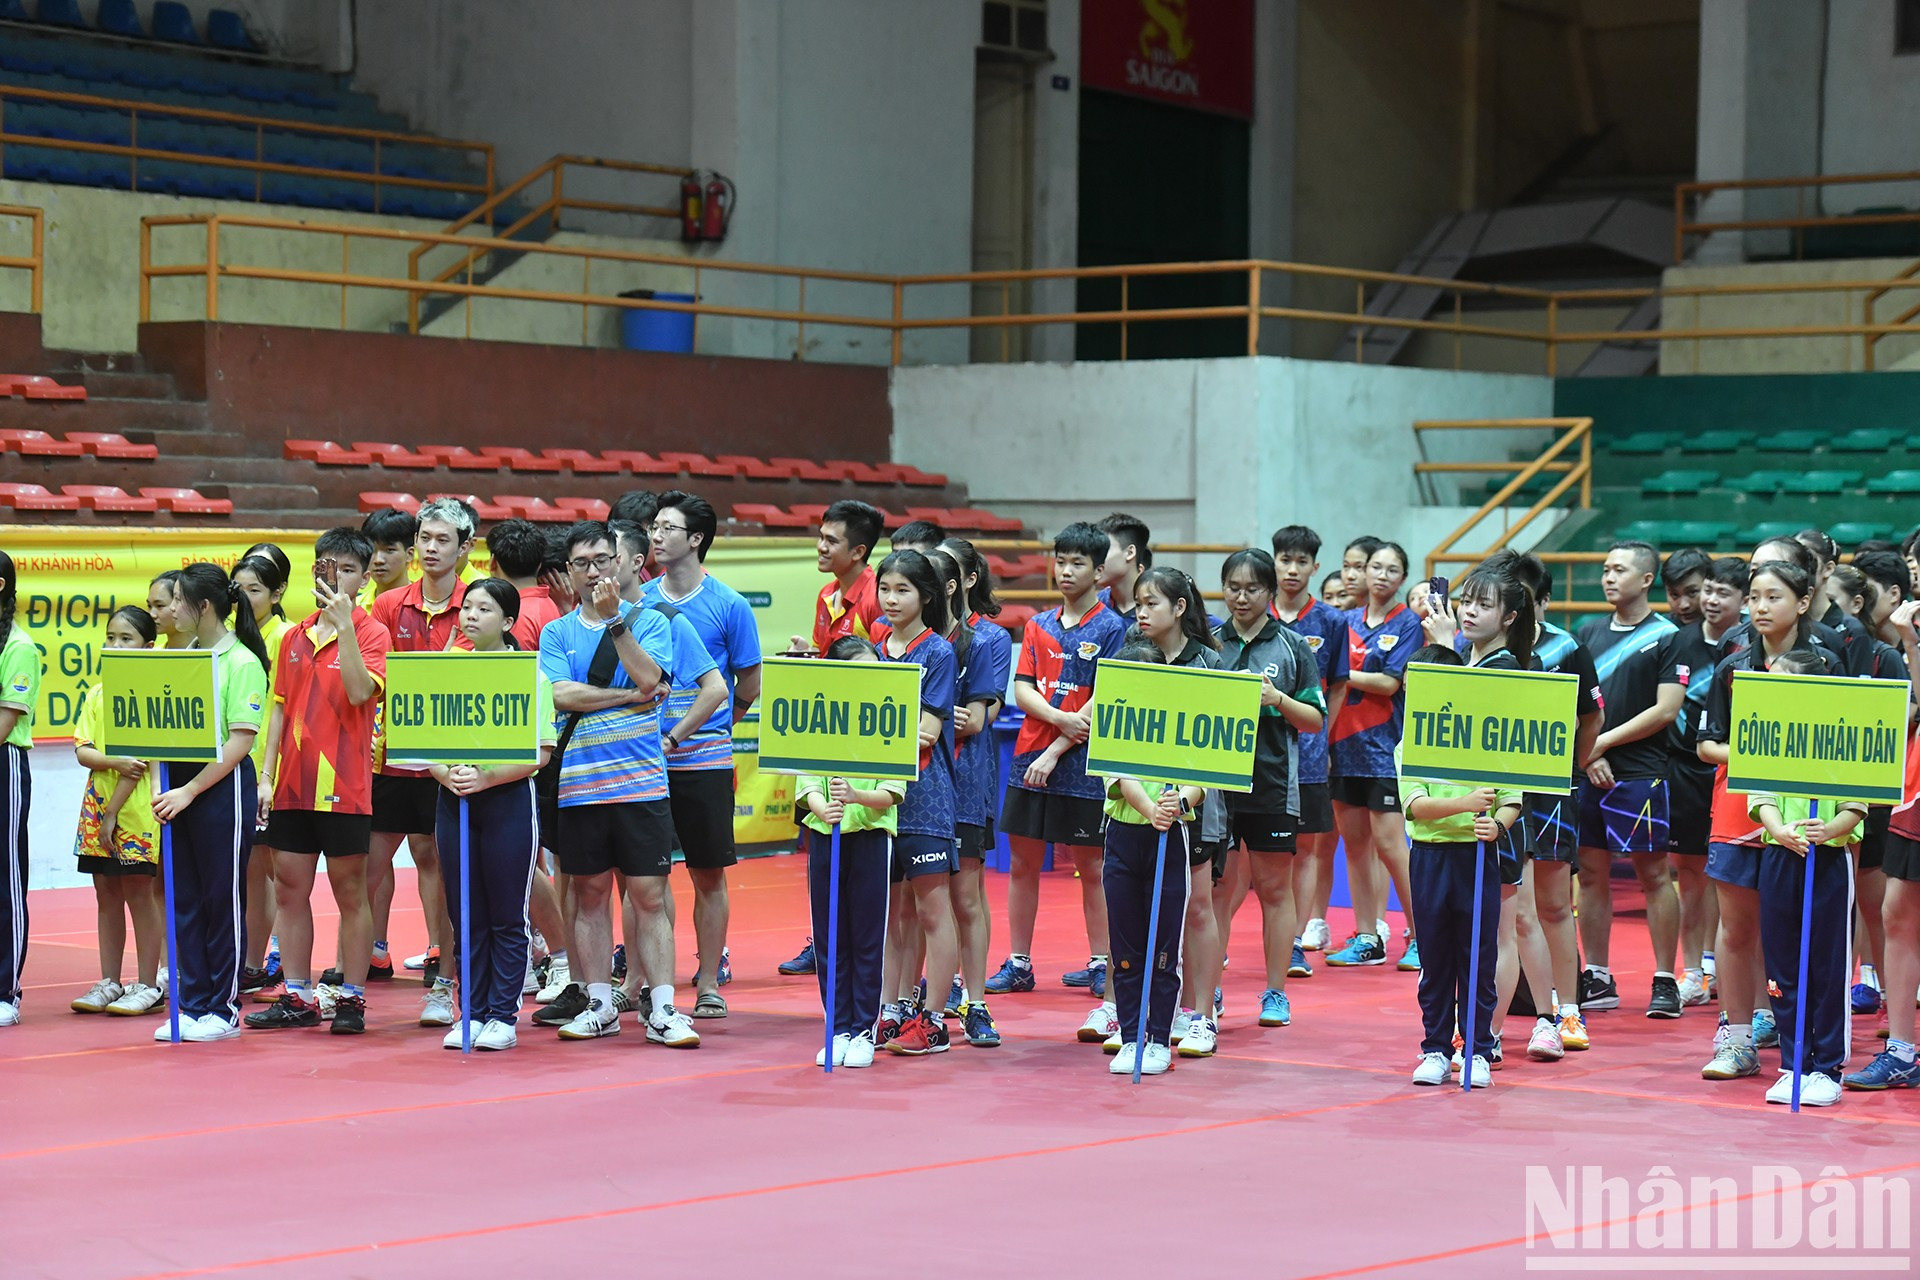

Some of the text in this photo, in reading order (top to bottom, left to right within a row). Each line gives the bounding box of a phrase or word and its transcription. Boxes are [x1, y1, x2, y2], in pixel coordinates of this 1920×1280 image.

[84, 552, 114, 571] HÒA
[25, 594, 116, 637] ĐỊCH
[113, 684, 205, 730] ĐÀ NẴNG
[391, 693, 531, 727] CLB TIMES CITY
[771, 692, 907, 746] QUÂN ĐỘI
[1096, 698, 1255, 754] VĨNH LONG
[1412, 701, 1567, 757] TIỀN GIANG
[1737, 712, 1897, 764] CÔNG AN NHÂN DÂN
[911, 851, 948, 865] XIOM
